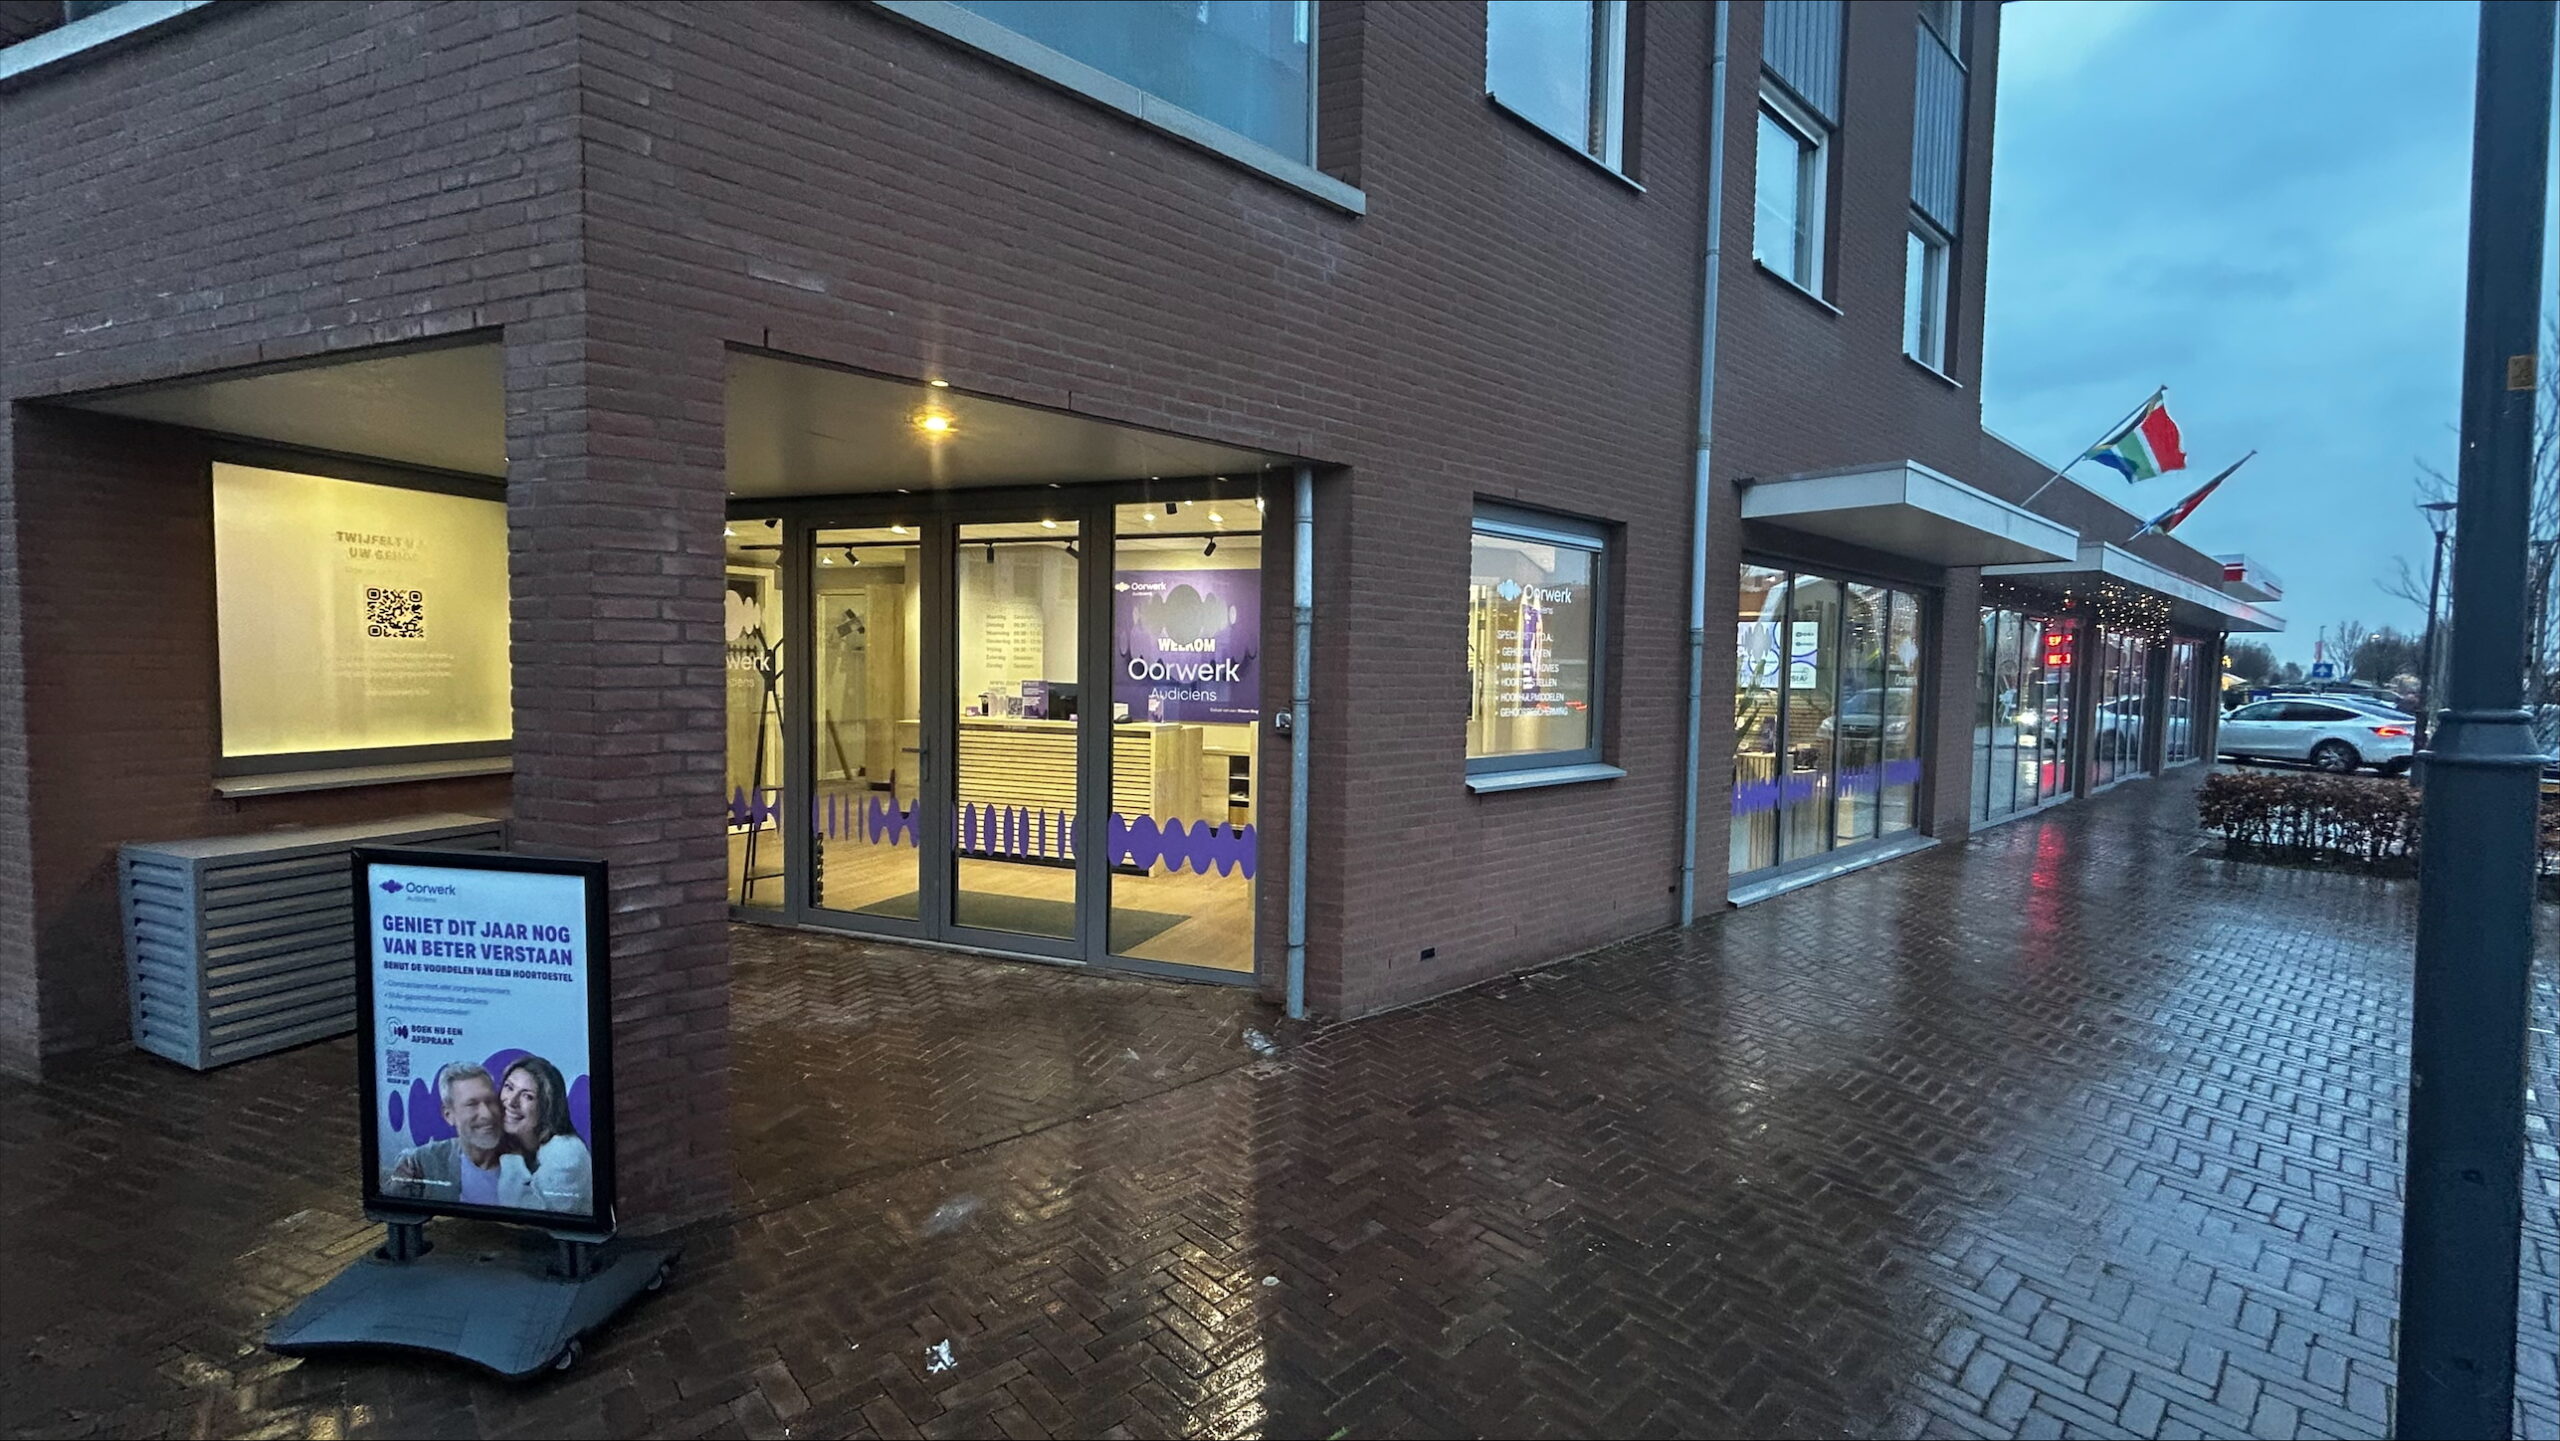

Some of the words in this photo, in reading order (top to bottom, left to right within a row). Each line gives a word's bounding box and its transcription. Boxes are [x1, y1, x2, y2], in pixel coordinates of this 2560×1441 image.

[1131, 582, 1166, 591] Oorwerk
[1523, 584, 1572, 604] Oorwerk
[1128, 658, 1240, 683] Oorwerk
[1150, 687, 1217, 702] Audiciens
[406, 882, 456, 896] Oorwerk
[382, 914, 444, 935] GENIET
[448, 919, 477, 937] DIT
[480, 921, 528, 940] JAAR
[532, 924, 571, 944] NOG
[382, 936, 417, 955] VAN
[421, 939, 477, 959] BETER
[480, 943, 573, 966] VERSTAAN
[383, 960, 410, 971] BENUT
[411, 963, 422, 972] DE
[423, 963, 475, 975] VOORDELEN
[475, 966, 493, 977] VAN
[495, 968, 511, 978] EEN
[513, 969, 574, 983] HOORTOESTEL
[411, 1024, 433, 1035] BOEK
[434, 1026, 446, 1035] NU
[447, 1027, 463, 1036] EEN
[411, 1035, 454, 1046] AFSPRAAK
